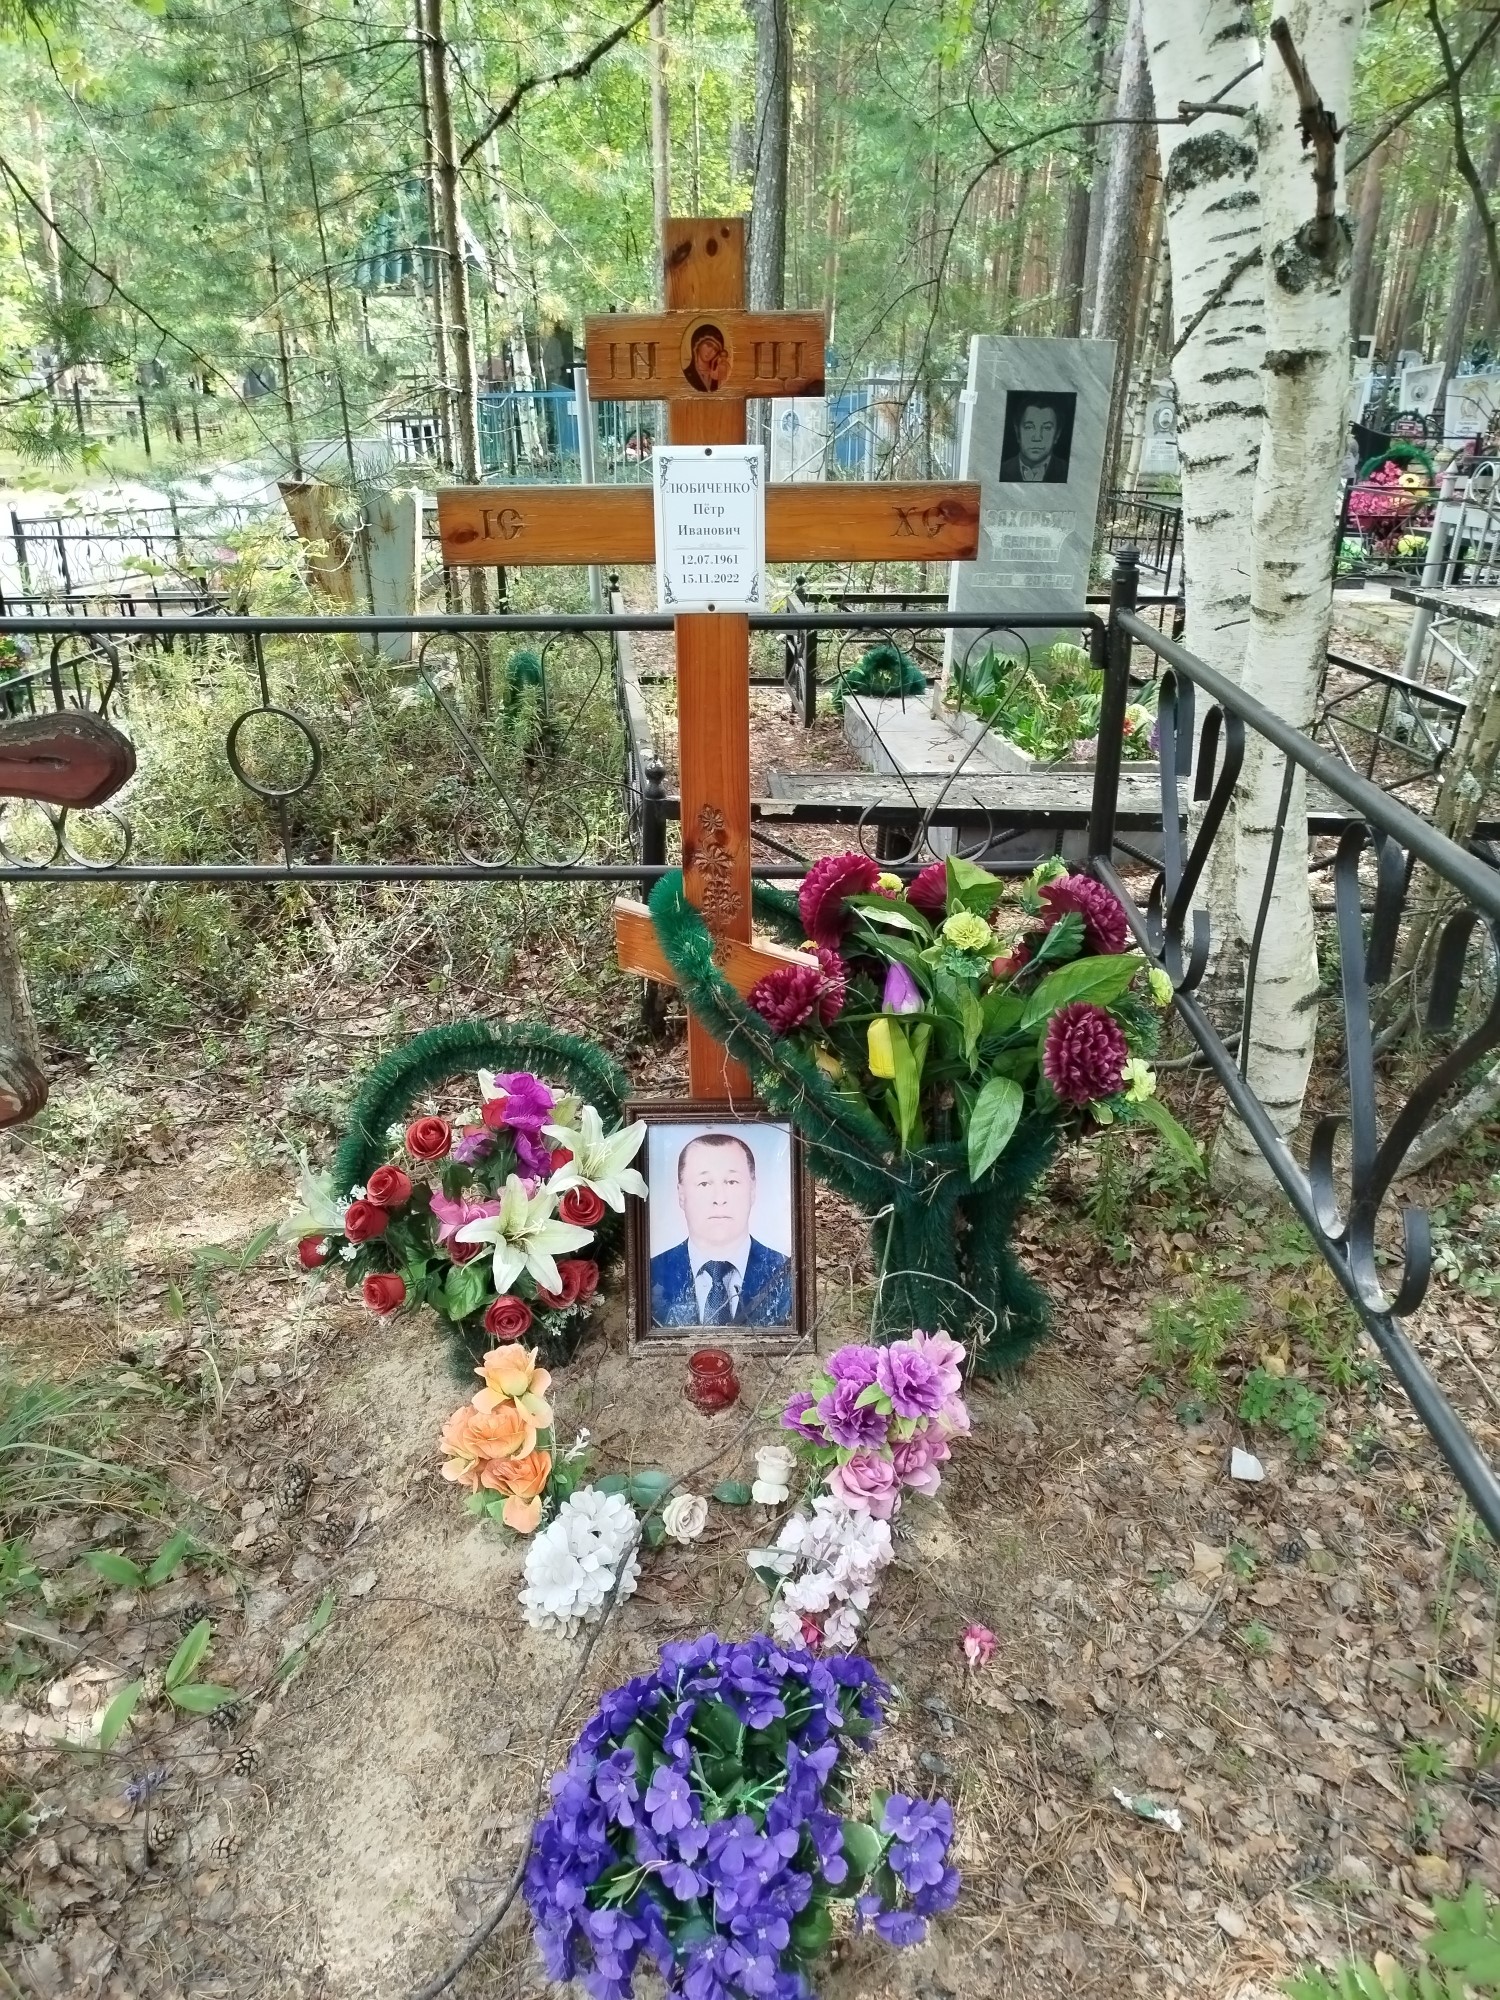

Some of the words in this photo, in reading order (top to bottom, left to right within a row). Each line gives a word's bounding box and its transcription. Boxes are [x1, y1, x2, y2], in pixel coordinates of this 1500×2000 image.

[666, 482, 750, 494] ЛЮБИЧЕНКО
[693, 503, 725, 517] Пётр
[677, 524, 741, 536] Иванович
[681, 555, 739, 565] 12.07.1961
[682, 573, 739, 584] 15.11.2022
